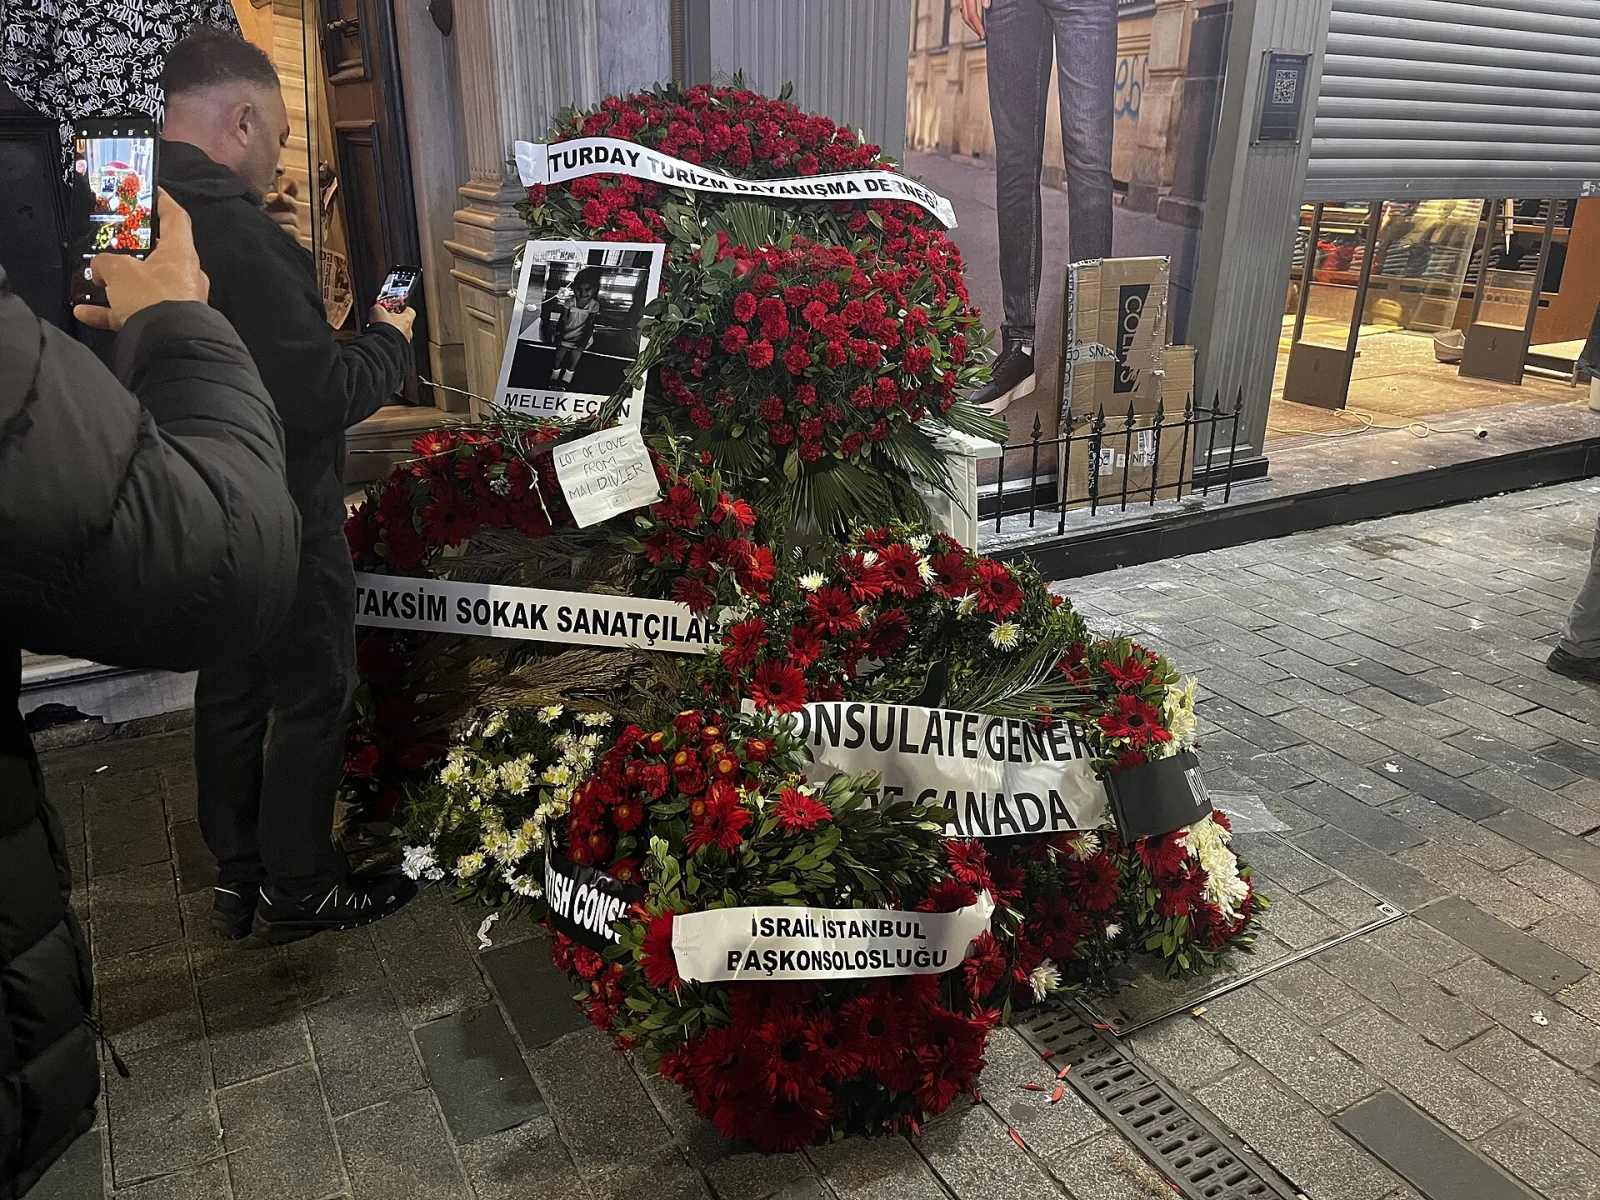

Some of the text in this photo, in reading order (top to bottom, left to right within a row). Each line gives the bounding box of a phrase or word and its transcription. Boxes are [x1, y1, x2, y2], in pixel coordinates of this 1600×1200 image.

[549, 146, 640, 173] TURDAY
[647, 156, 729, 190] TURİZM
[734, 180, 861, 197] DAYANIŞMA
[504, 393, 631, 418] MELEK ECN
[559, 436, 628, 467] LOT OF LOVE
[583, 456, 617, 477] FROM
[456, 597, 549, 631] SOKAK
[791, 703, 1101, 763] ONSULATE GENER
[751, 913, 927, 940] İSRAİL İSTANBUL
[727, 945, 948, 977] BAŞKONSOLOSLUĞU
